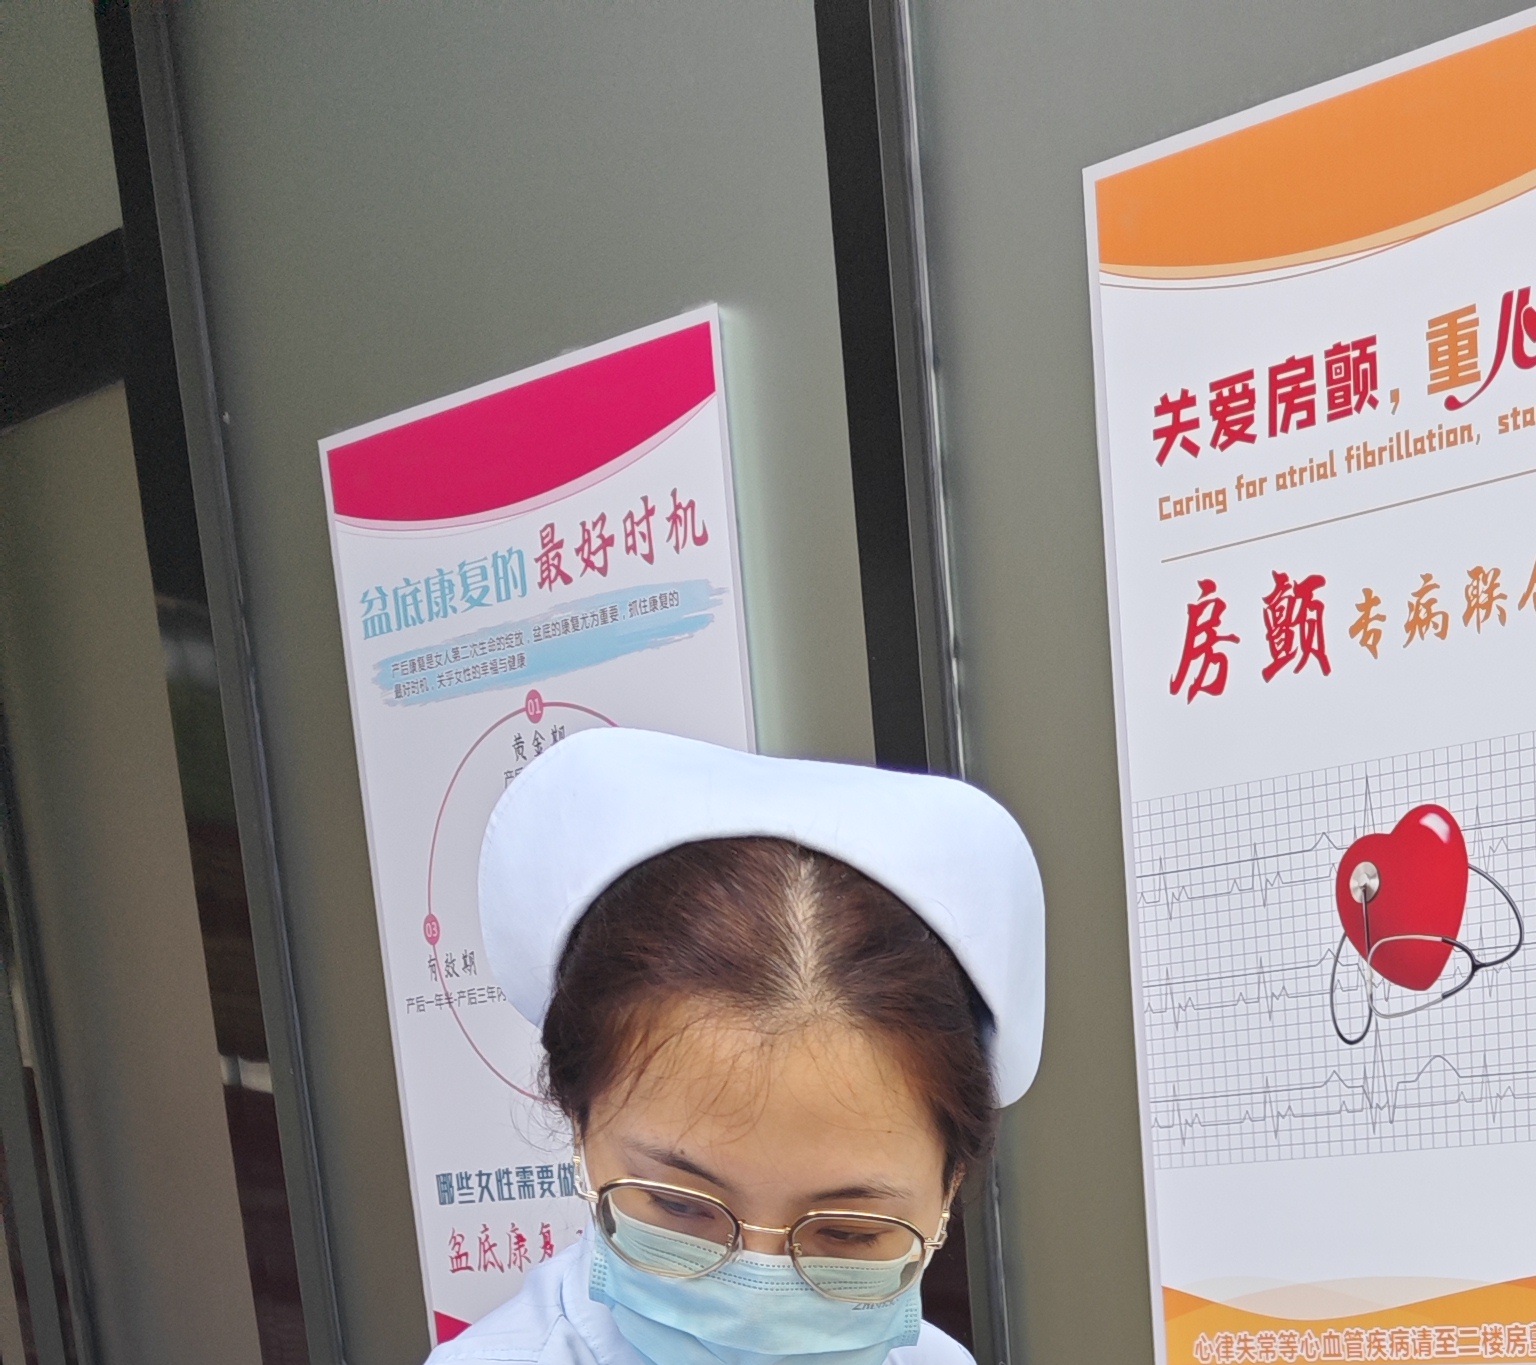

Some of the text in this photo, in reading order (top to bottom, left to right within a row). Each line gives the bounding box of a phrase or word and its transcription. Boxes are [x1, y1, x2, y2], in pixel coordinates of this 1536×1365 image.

[1158, 483, 1228, 521] Caring
[1235, 473, 1268, 502] for
[1275, 450, 1338, 492] atrial
[1345, 422, 1482, 475] fibrillation,
[527, 698, 542, 716] 01
[425, 921, 439, 938] 03
[427, 949, 478, 982] 有效期
[449, 1222, 583, 1274] 盆底康复
